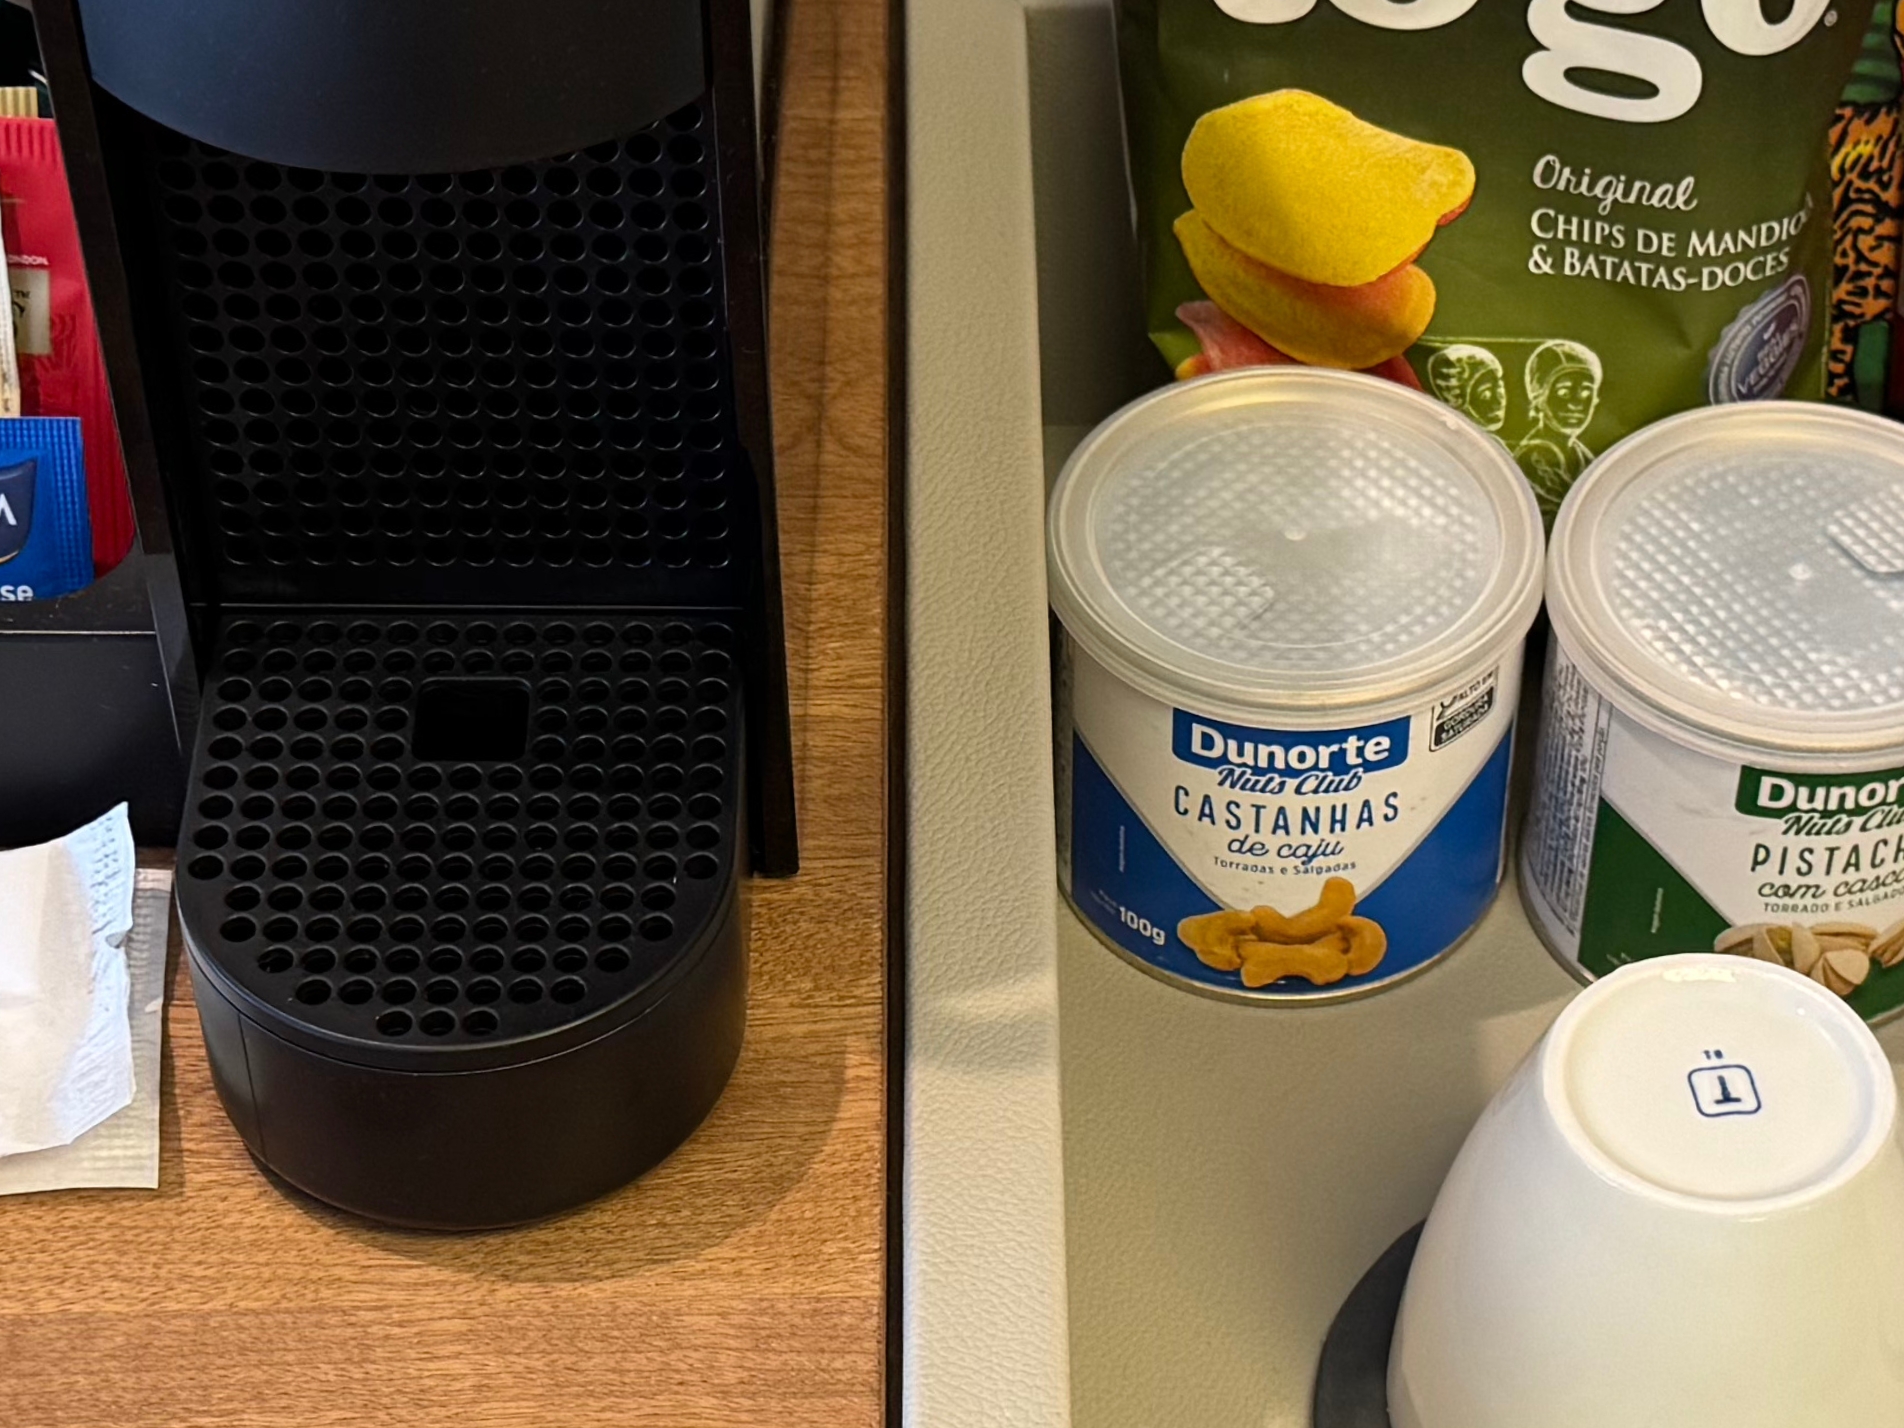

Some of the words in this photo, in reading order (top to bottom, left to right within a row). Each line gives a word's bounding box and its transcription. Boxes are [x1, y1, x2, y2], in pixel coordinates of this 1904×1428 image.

[1532, 153, 1698, 216] Original
[1530, 207, 1626, 250] CHIPS
[1637, 228, 1676, 258] DE
[1687, 192, 1814, 258] MANDIO
[1528, 243, 1555, 275] &
[1563, 246, 1791, 292] BATATAS-DOCES
[1190, 722, 1391, 770] Dunorte
[1216, 767, 1287, 795] Nuts
[1294, 770, 1363, 795] Club
[1174, 784, 1400, 837] CASTANHAS
[1781, 810, 1860, 837] Nuts
[1214, 855, 1274, 874] Torradas
[1227, 833, 1270, 857] de
[1277, 838, 1345, 866] caju
[1757, 878, 1827, 901] com
[1764, 902, 1831, 914] TORRADO
[1119, 905, 1166, 947] 100g
